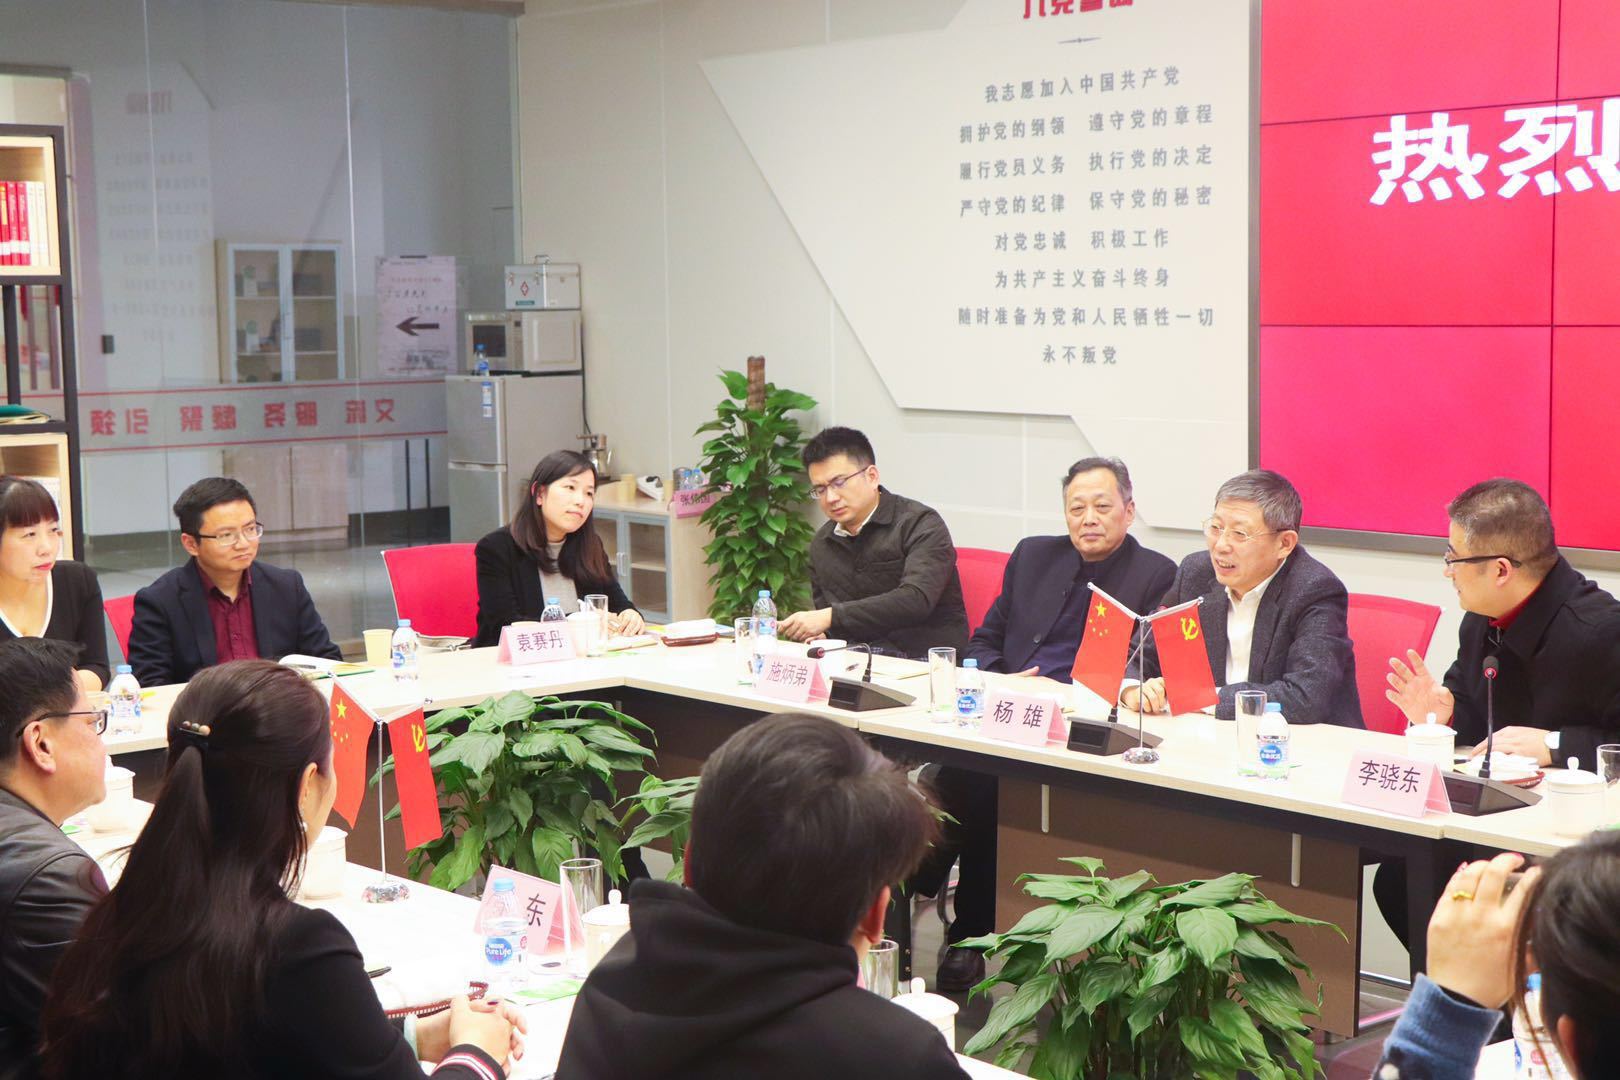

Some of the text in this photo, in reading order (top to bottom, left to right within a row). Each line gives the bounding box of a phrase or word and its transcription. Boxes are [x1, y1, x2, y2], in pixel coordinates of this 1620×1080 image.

[984, 66, 1181, 103] 我志愿加入中国共产党
[959, 104, 1213, 144] 拥护党的纲领 遵守党的章程
[959, 144, 1213, 180] 履行党员义务 执行党的决定
[1369, 97, 1620, 206] 热烈
[959, 185, 1213, 217] 严守党的纪律 保守党的秘密
[994, 227, 1169, 251] 对党忠诚 积极工作
[994, 267, 1169, 289] 为共产主义奋斗终身
[958, 306, 1213, 327] 随时准备为党和人民牺牲一切
[1042, 344, 1117, 364] 永不叛党
[517, 629, 564, 652] 袁赛丹
[1358, 760, 1421, 794] 李骁东
